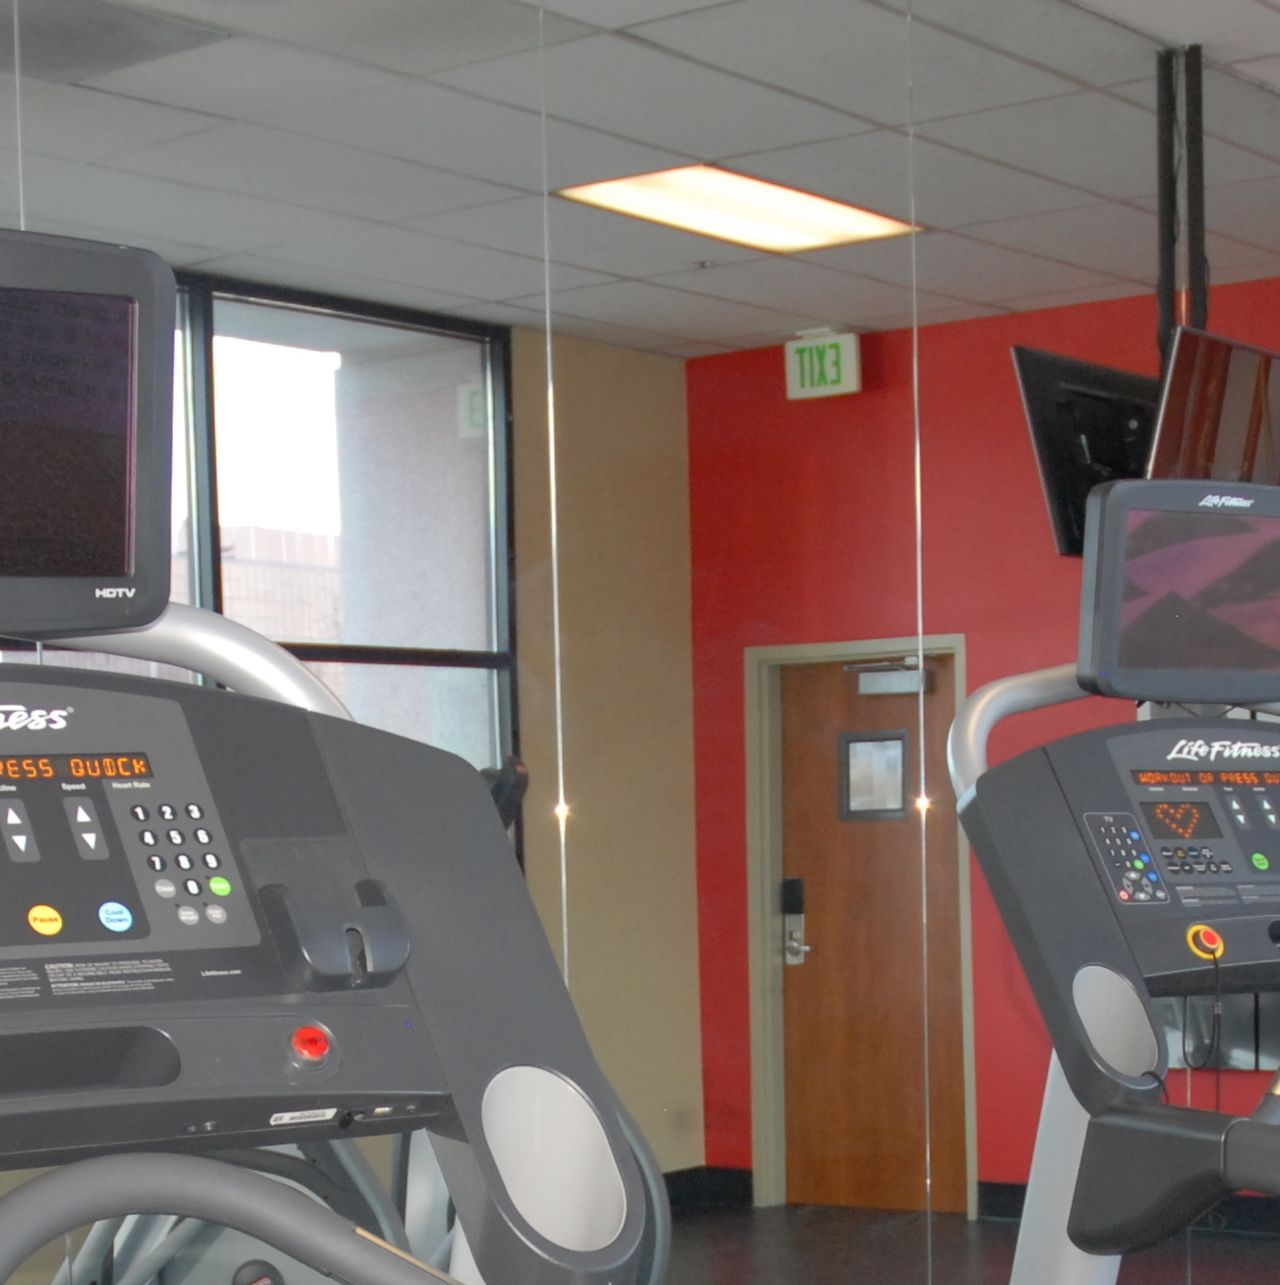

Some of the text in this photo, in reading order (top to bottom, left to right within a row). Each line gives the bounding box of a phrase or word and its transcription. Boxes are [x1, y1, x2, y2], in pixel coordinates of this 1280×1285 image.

[95, 588, 136, 598] HDTV
[1167, 740, 1280, 761] Life Fitness
[61, 783, 86, 791] Speed
[134, 804, 201, 821] 1 2 3
[143, 831, 155, 846] 4
[169, 830, 182, 845] 5
[150, 856, 161, 871] 7
